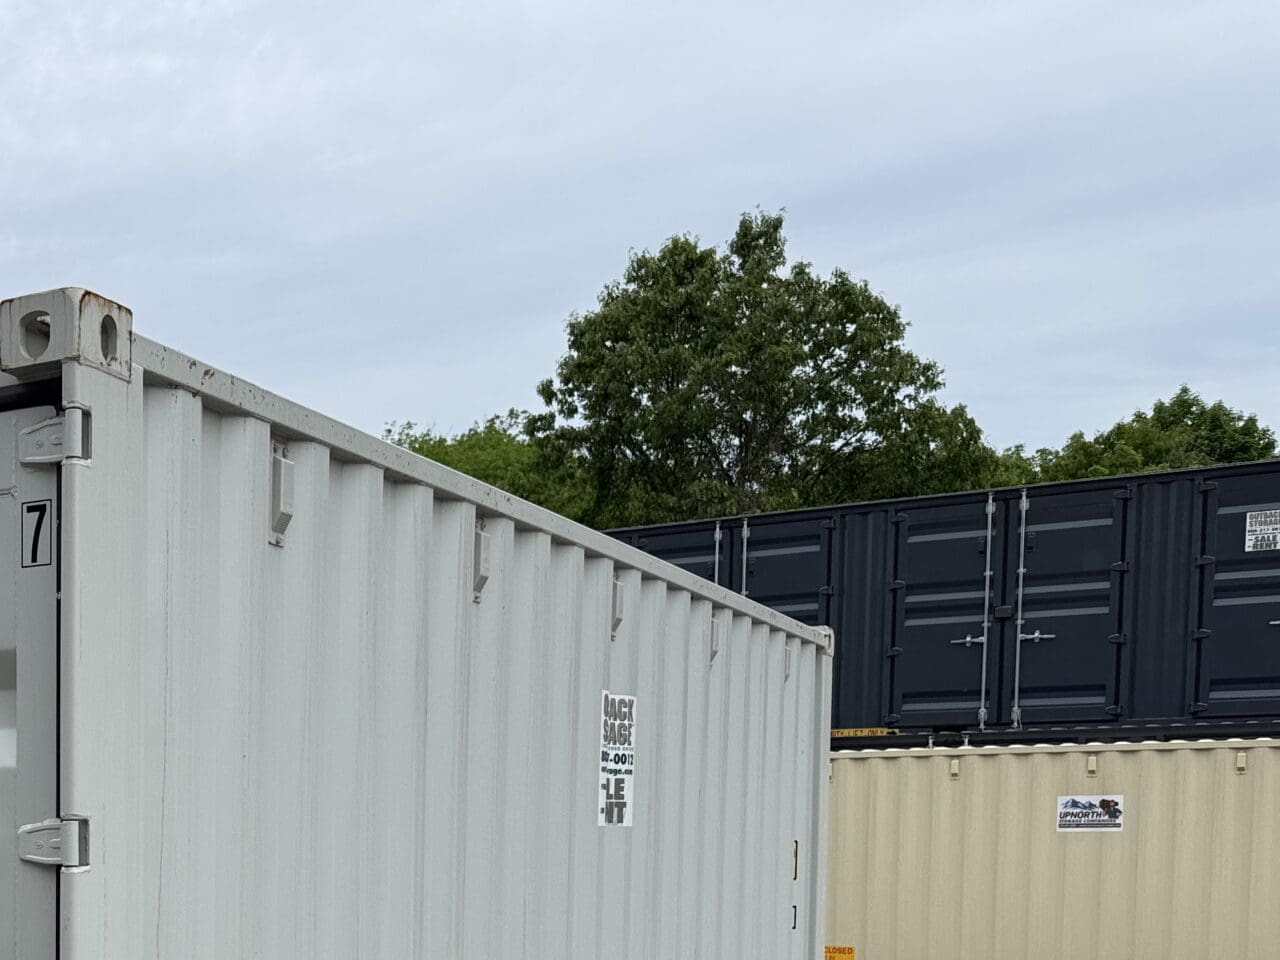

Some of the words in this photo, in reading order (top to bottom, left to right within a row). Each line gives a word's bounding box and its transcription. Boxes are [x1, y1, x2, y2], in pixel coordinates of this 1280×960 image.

[1249, 512, 1280, 520] OUTBAC
[1249, 519, 1280, 527] STORAG
[25, 502, 49, 564] 7
[1059, 811, 1102, 819] UPNORTH
